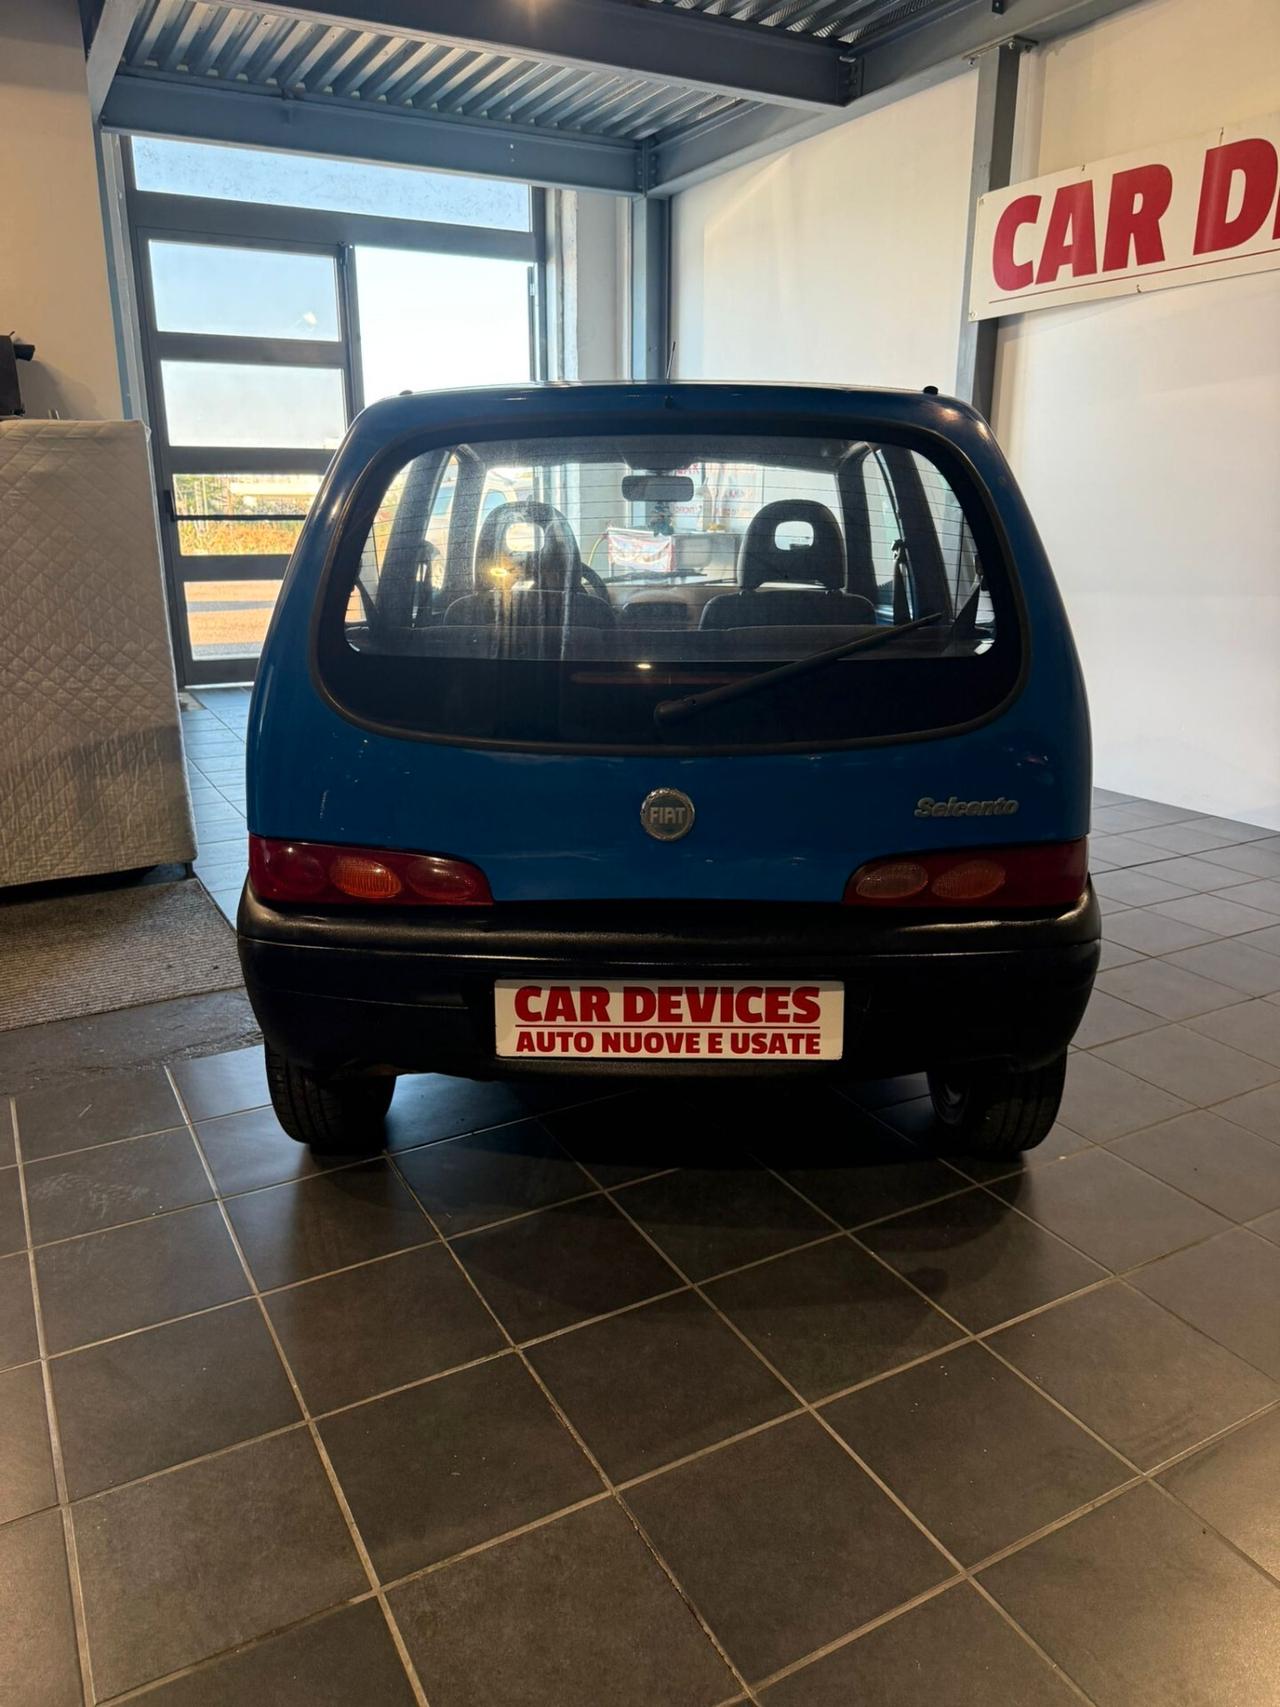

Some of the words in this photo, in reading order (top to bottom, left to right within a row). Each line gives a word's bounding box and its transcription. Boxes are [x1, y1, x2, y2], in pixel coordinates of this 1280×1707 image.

[992, 163, 1173, 291] CAR
[1193, 138, 1280, 255] D
[650, 806, 686, 824] FIAT
[514, 985, 611, 1023] CAR
[623, 986, 821, 1024] DEVICES
[516, 1031, 594, 1053] AUTO
[602, 1032, 701, 1054] NUOVE
[708, 1032, 723, 1054] E
[730, 1033, 821, 1055] USATE
